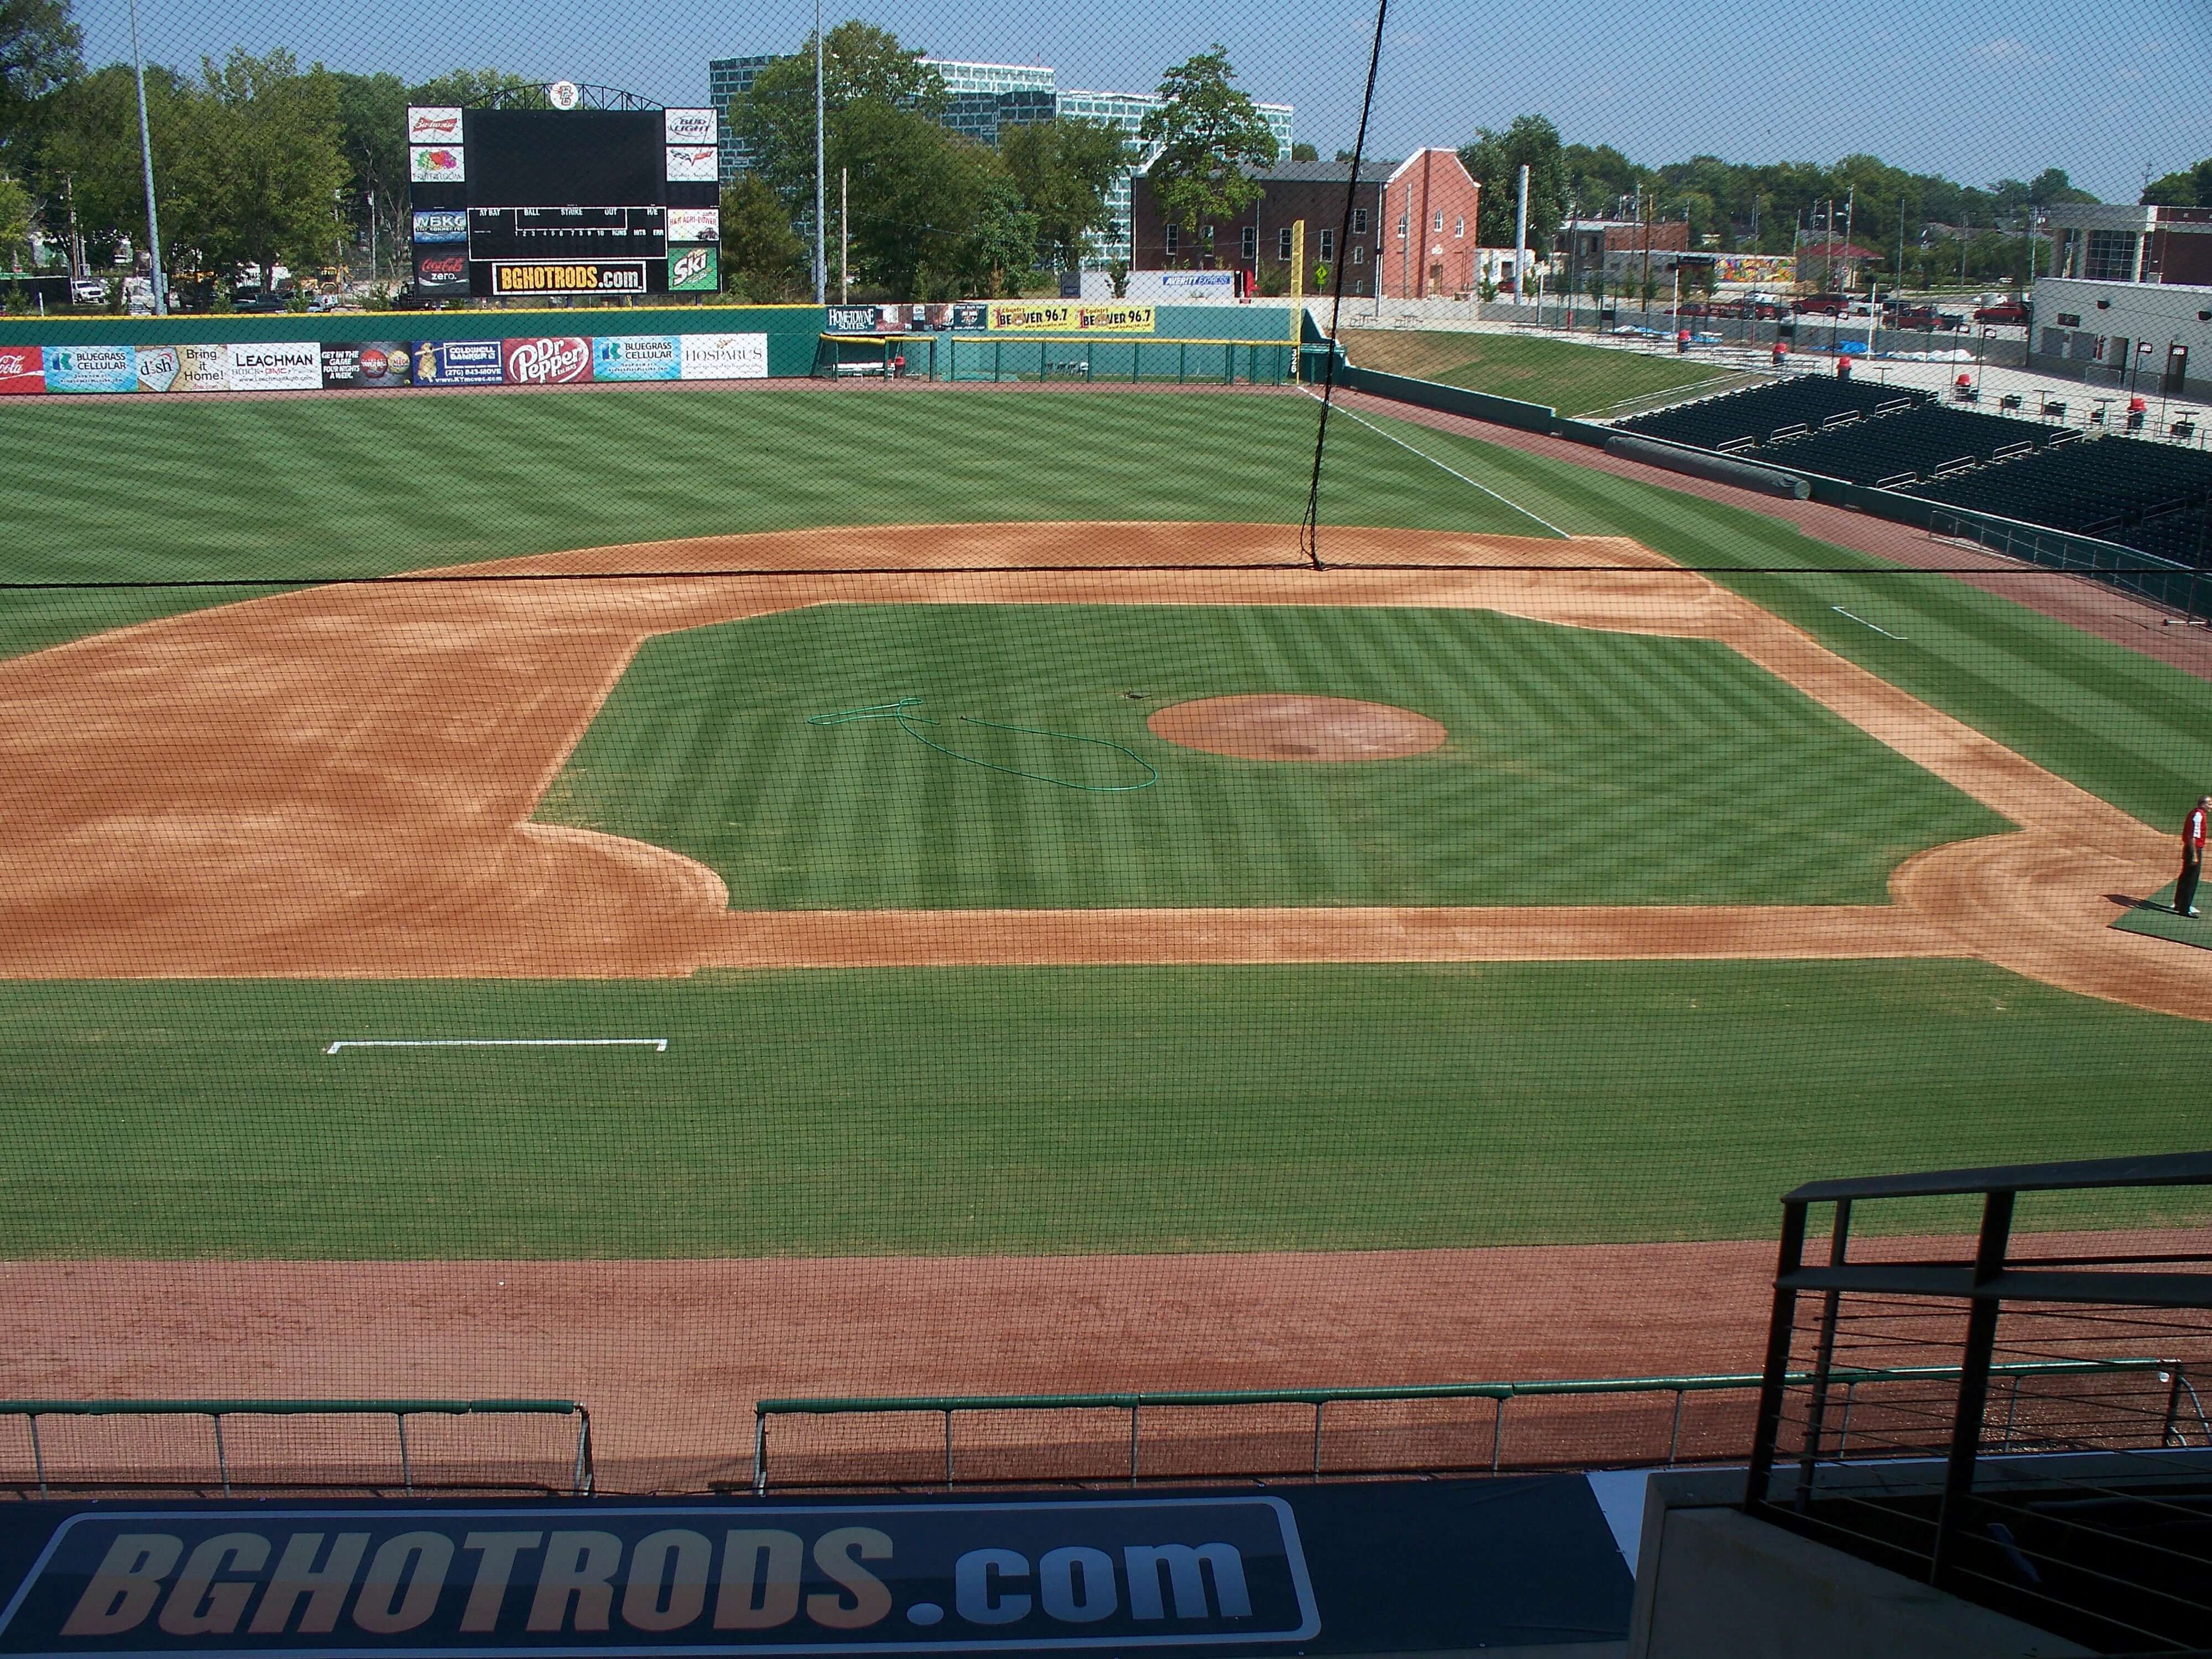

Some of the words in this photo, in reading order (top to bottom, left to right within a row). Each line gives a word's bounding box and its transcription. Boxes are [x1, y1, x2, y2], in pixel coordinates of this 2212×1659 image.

[501, 267, 638, 289] BGHOTRODS.com
[1165, 276, 1198, 285] AVERITT
[1198, 276, 1229, 285] EXPRESS
[1046, 309, 1067, 321] 96.7
[1129, 309, 1151, 323] 96.7
[536, 338, 565, 362] Dr
[625, 342, 672, 350] BLUEGRASS
[77, 353, 126, 362] BLUEGRASS
[186, 349, 217, 361] Bring
[236, 353, 313, 368] LEACHMAN
[625, 351, 672, 359] CELLULAR
[685, 349, 762, 361] HOSPARUS
[77, 362, 126, 370] CELLULAR
[140, 358, 172, 376] dish
[199, 361, 207, 371] it
[509, 344, 583, 383] Pepper
[184, 370, 224, 381] Home!
[59, 1525, 1254, 1637] BGHOTRODS.com
